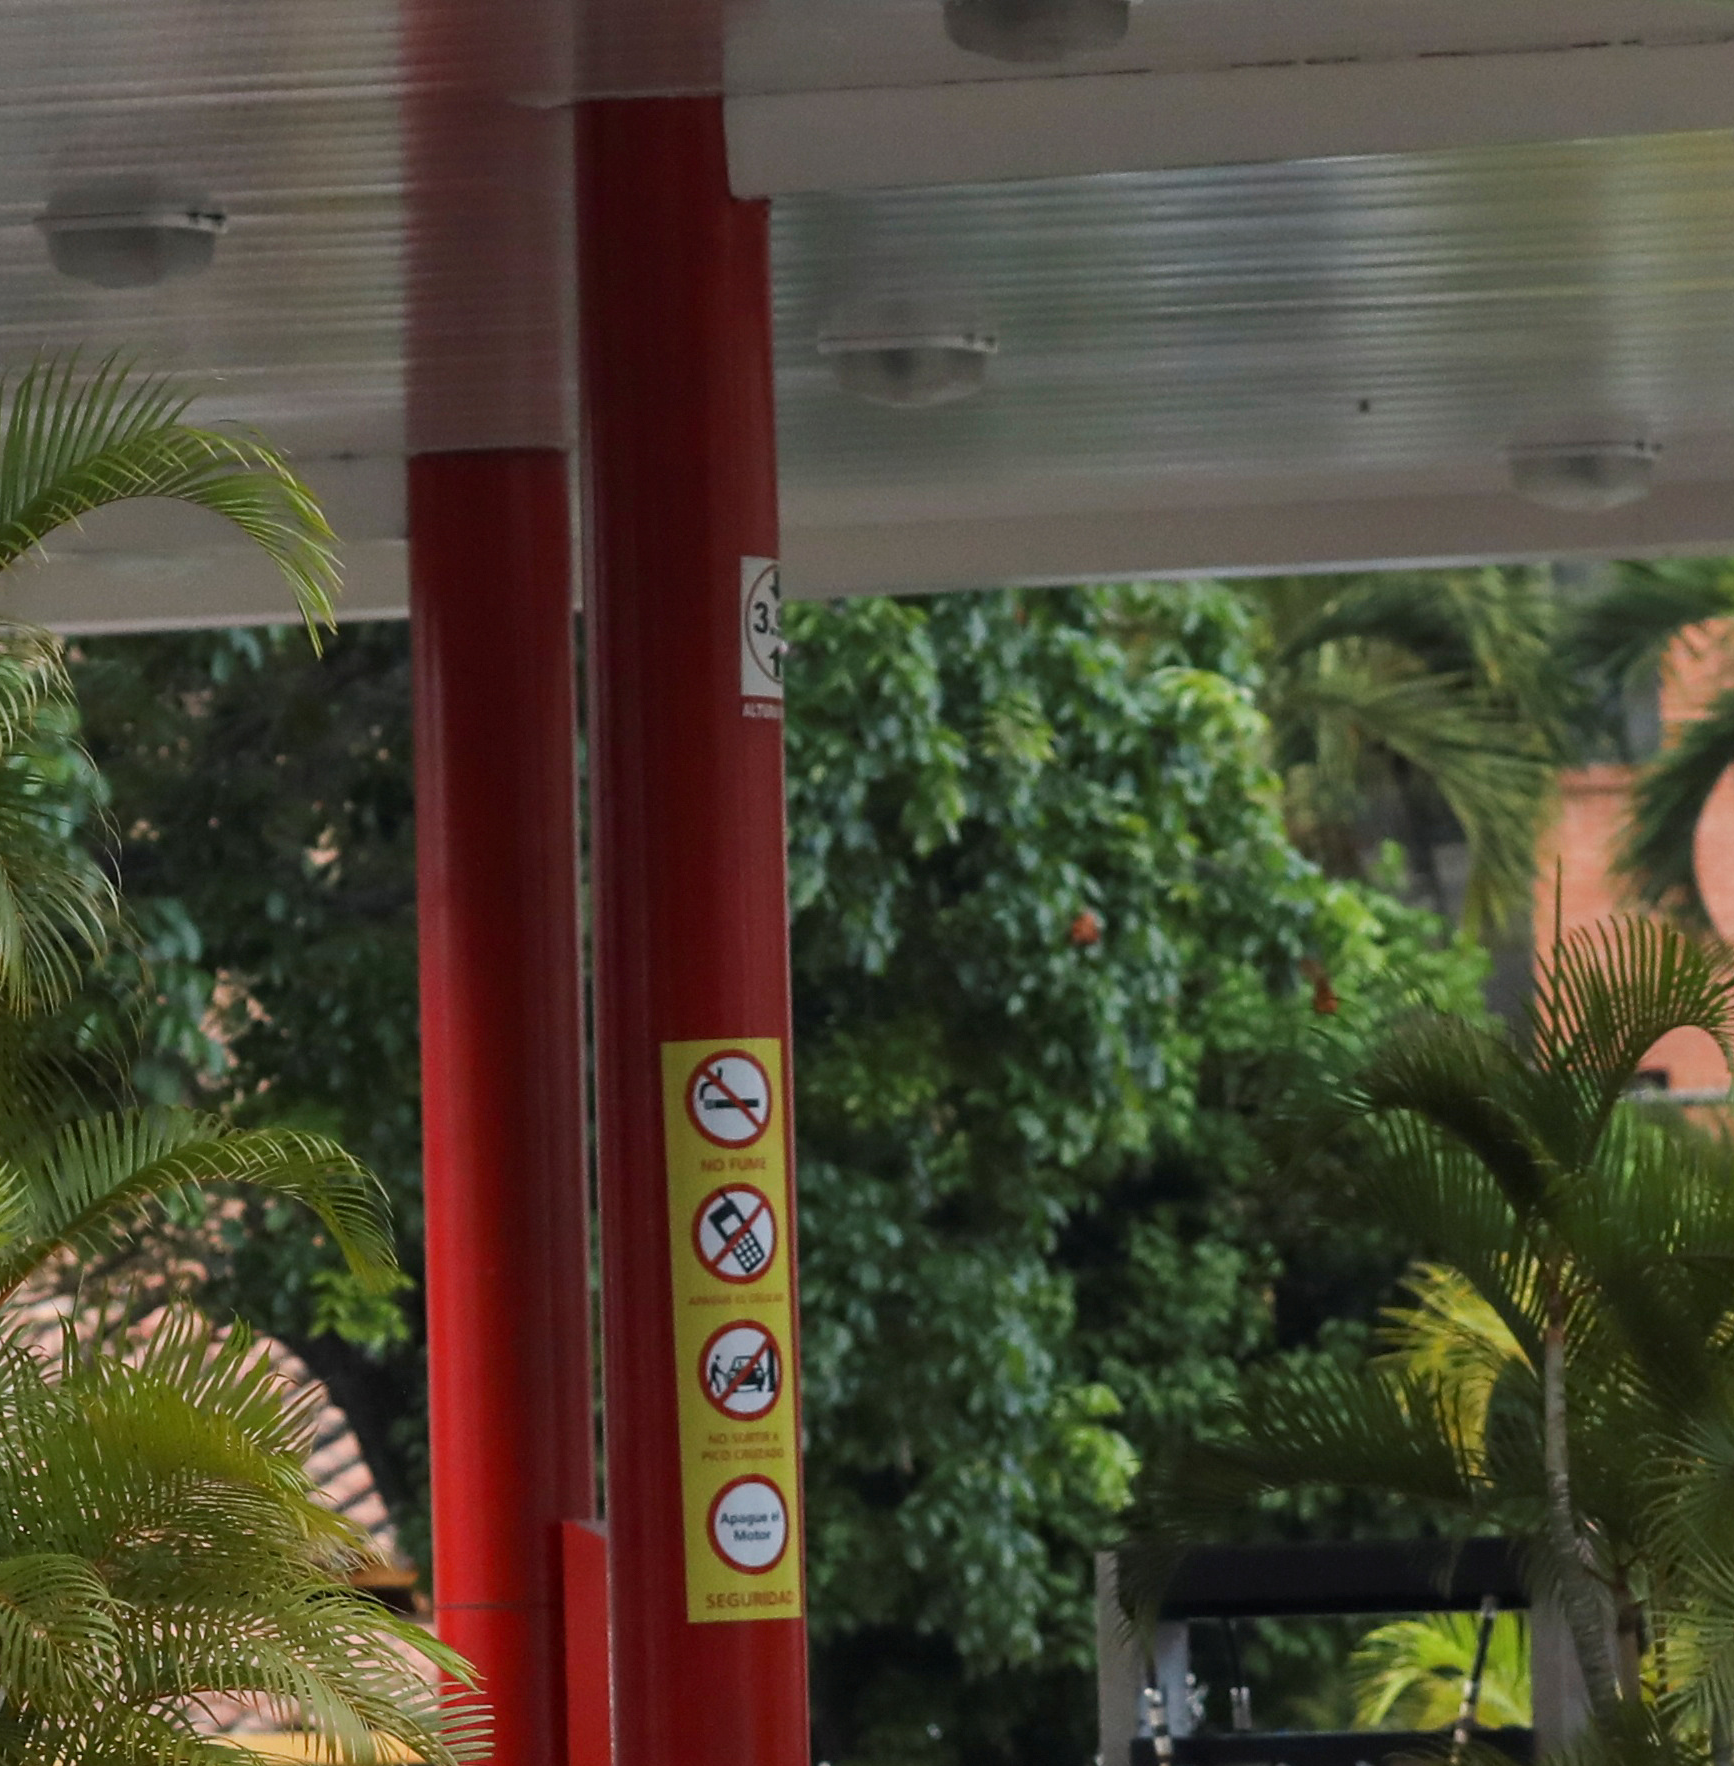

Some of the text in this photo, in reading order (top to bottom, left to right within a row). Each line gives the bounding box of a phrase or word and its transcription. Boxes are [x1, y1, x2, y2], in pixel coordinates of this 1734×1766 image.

[720, 1512, 768, 1527] Apague
[733, 1529, 771, 1541] Motor
[705, 1590, 795, 1609] SEGURIDAD
